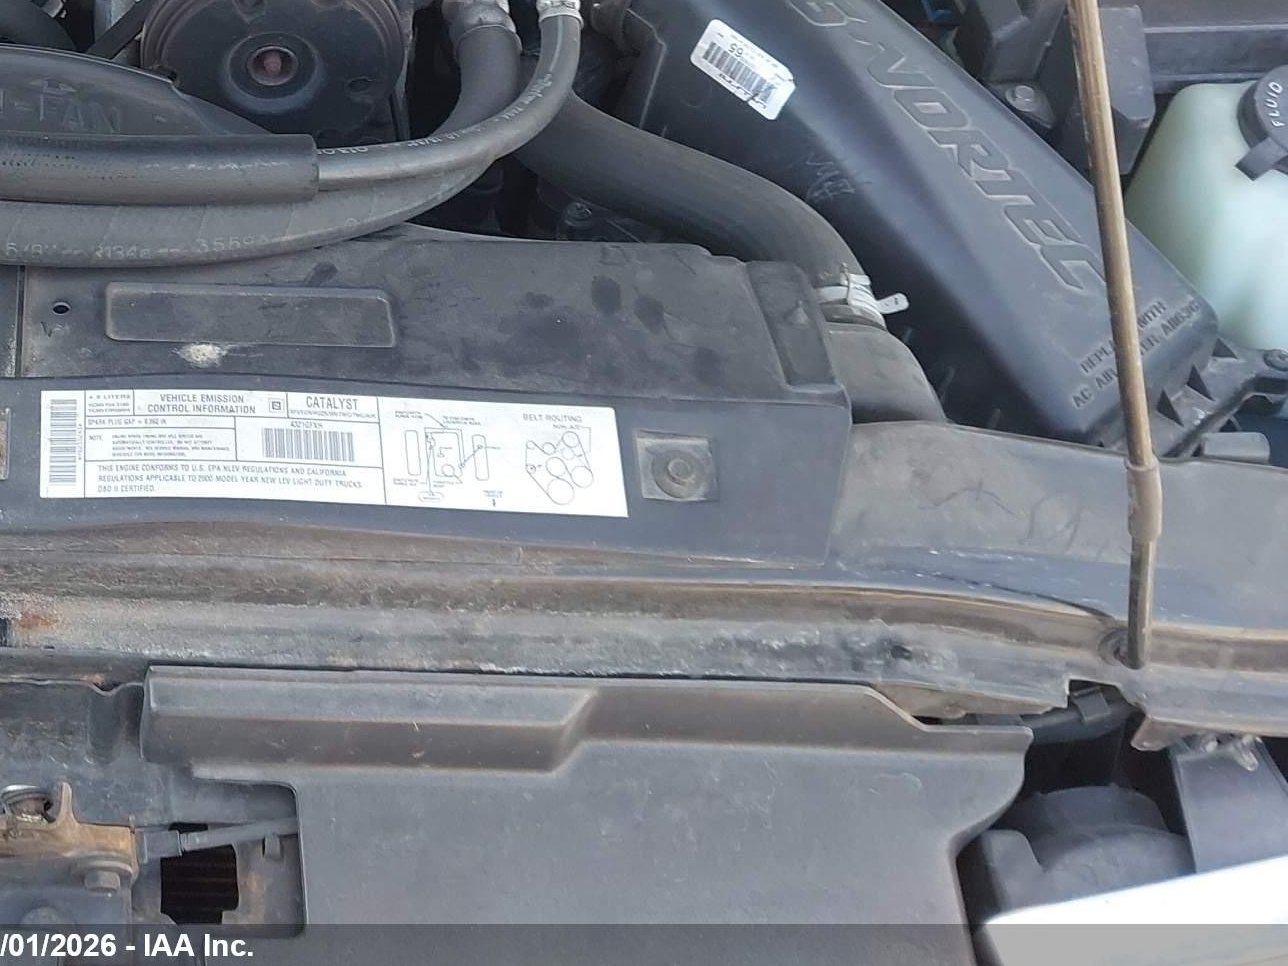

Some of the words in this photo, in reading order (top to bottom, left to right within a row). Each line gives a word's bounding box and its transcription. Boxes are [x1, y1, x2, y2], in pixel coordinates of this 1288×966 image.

[160, 394, 197, 402] VEHICLE
[201, 394, 244, 403] EMISSION
[306, 395, 359, 410] CATALYST
[147, 404, 189, 413] CONTROL
[192, 404, 256, 414] INFORMATION
[523, 413, 542, 421] BELT
[545, 413, 583, 423] ROUTING
[98, 464, 113, 472] THIS
[115, 464, 140, 472] ENGINE
[142, 464, 179, 472] CONFORMS
[242, 465, 289, 475] REGULATIONS
[291, 467, 304, 475] AND
[306, 467, 347, 476] CALIFORNIA
[98, 474, 144, 482] REGULATIONS
[146, 474, 186, 482] APPLICABLE
[187, 474, 196, 482] TO
[216, 475, 238, 483] MODEL
[240, 475, 259, 483] YEAR
[261, 476, 276, 484] NEW
[293, 477, 312, 486] LIGHT
[314, 478, 332, 487] DUTY
